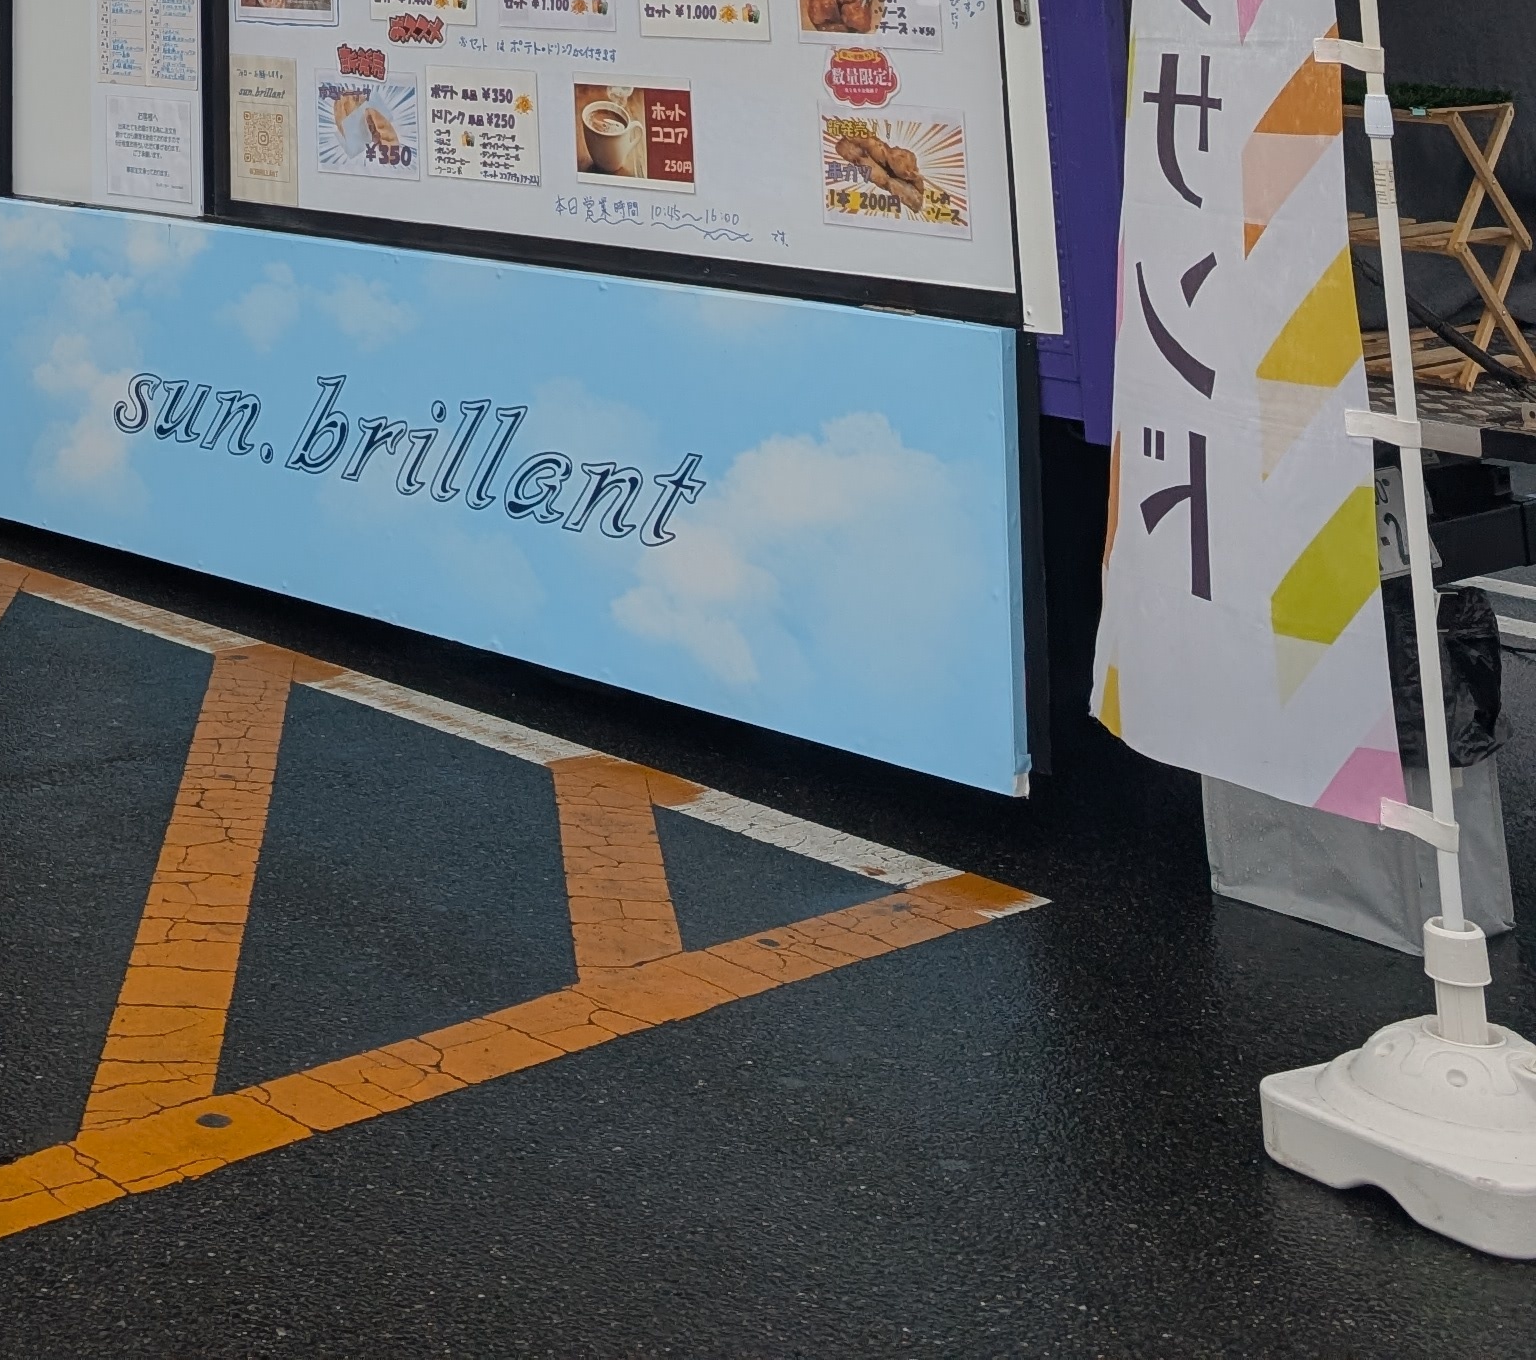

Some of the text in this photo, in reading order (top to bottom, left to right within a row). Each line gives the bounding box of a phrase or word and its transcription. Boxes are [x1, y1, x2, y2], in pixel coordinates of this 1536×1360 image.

[644, 4, 670, 19] セット
[831, 66, 892, 87] 数量限定!
[430, 84, 458, 100] ポテト
[481, 87, 513, 104] ¥350
[431, 108, 466, 125] ドリンク
[486, 113, 516, 129] ¥250
[651, 102, 686, 121] ホット
[651, 126, 688, 145] ココア
[365, 142, 412, 167] ¥350
[664, 159, 693, 174] 250円
[825, 160, 871, 183] 串カツ
[859, 191, 902, 214] 200円
[113, 370, 706, 549] sun.brillant
